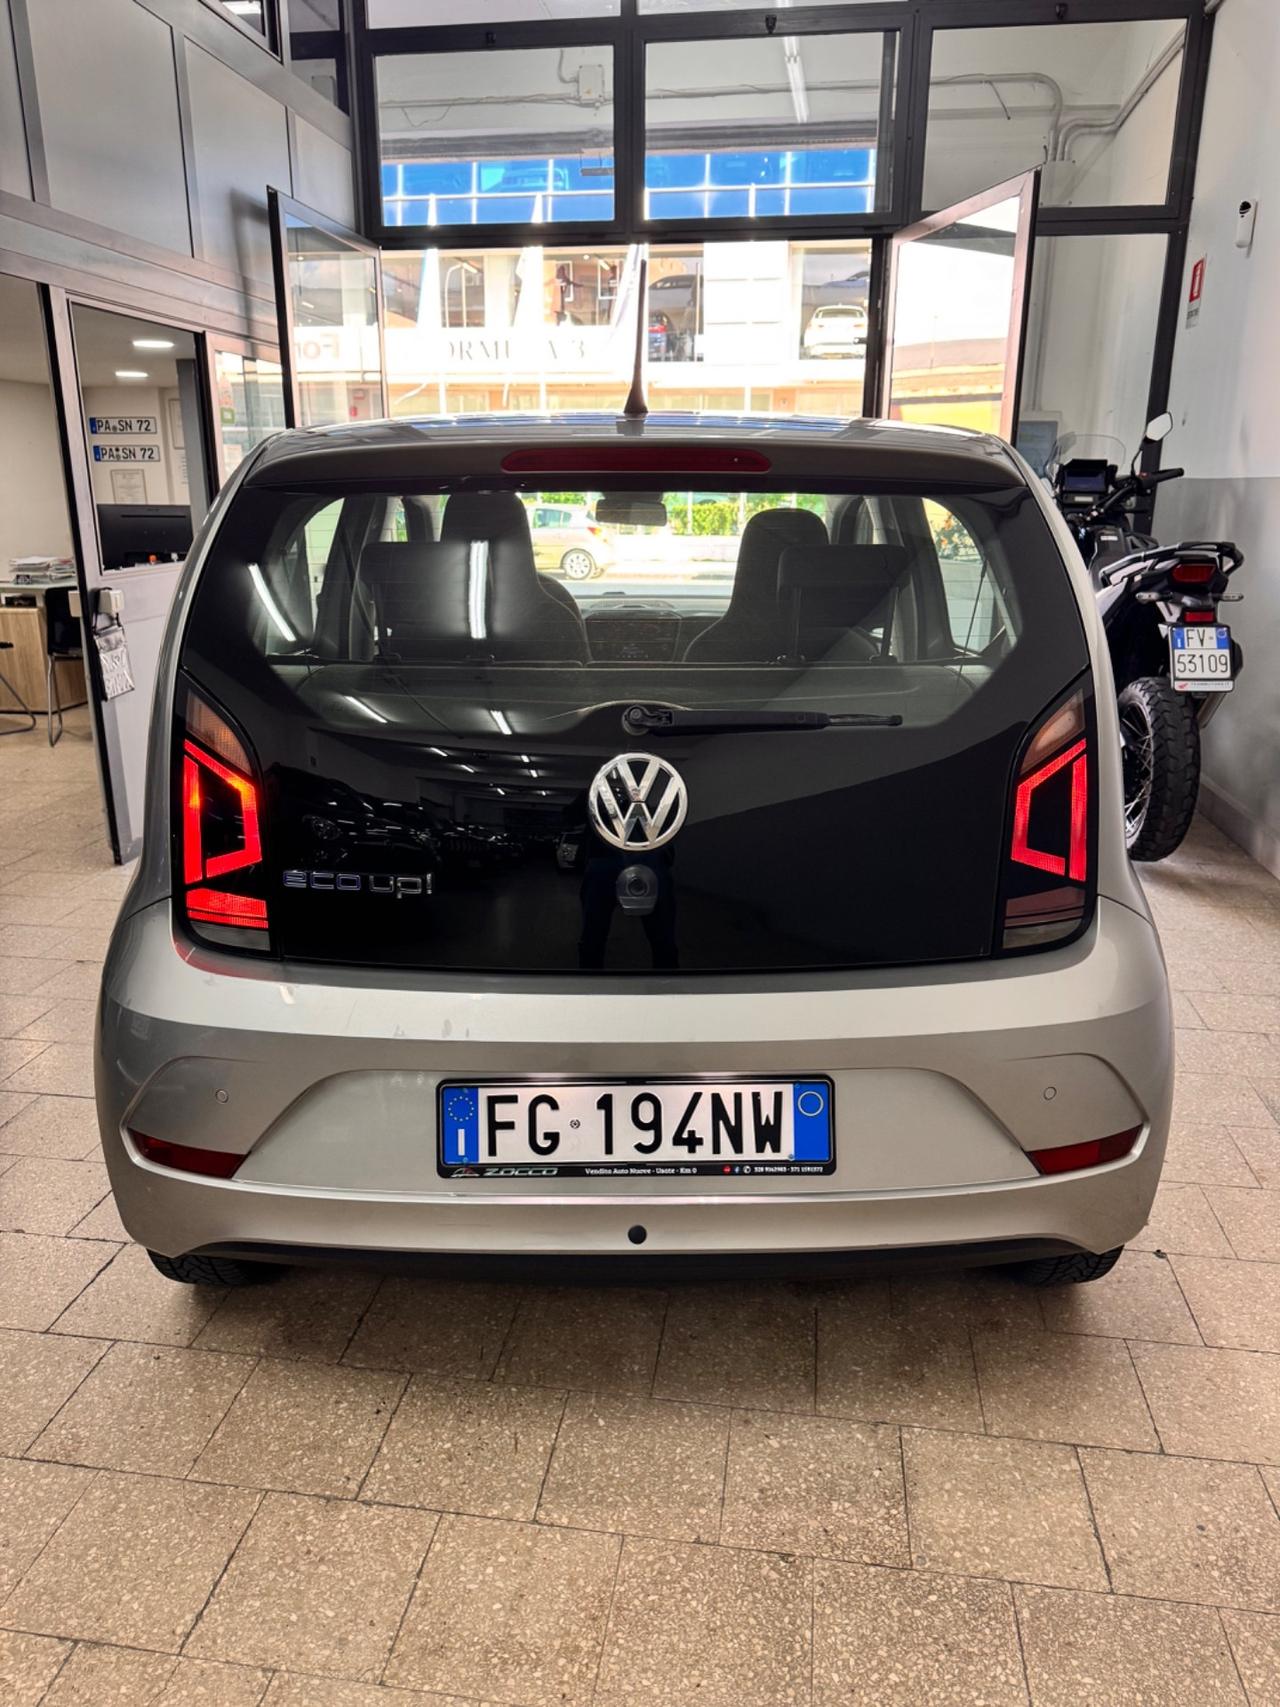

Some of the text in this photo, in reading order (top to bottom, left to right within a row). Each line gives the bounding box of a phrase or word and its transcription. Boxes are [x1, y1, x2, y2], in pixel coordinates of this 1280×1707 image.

[137, 419, 151, 432] 72
[140, 447, 155, 460] 72
[1186, 628, 1206, 648] FV
[1177, 654, 1229, 673] 53109
[368, 873, 433, 899] up!
[486, 1090, 784, 1157] FG 194NW
